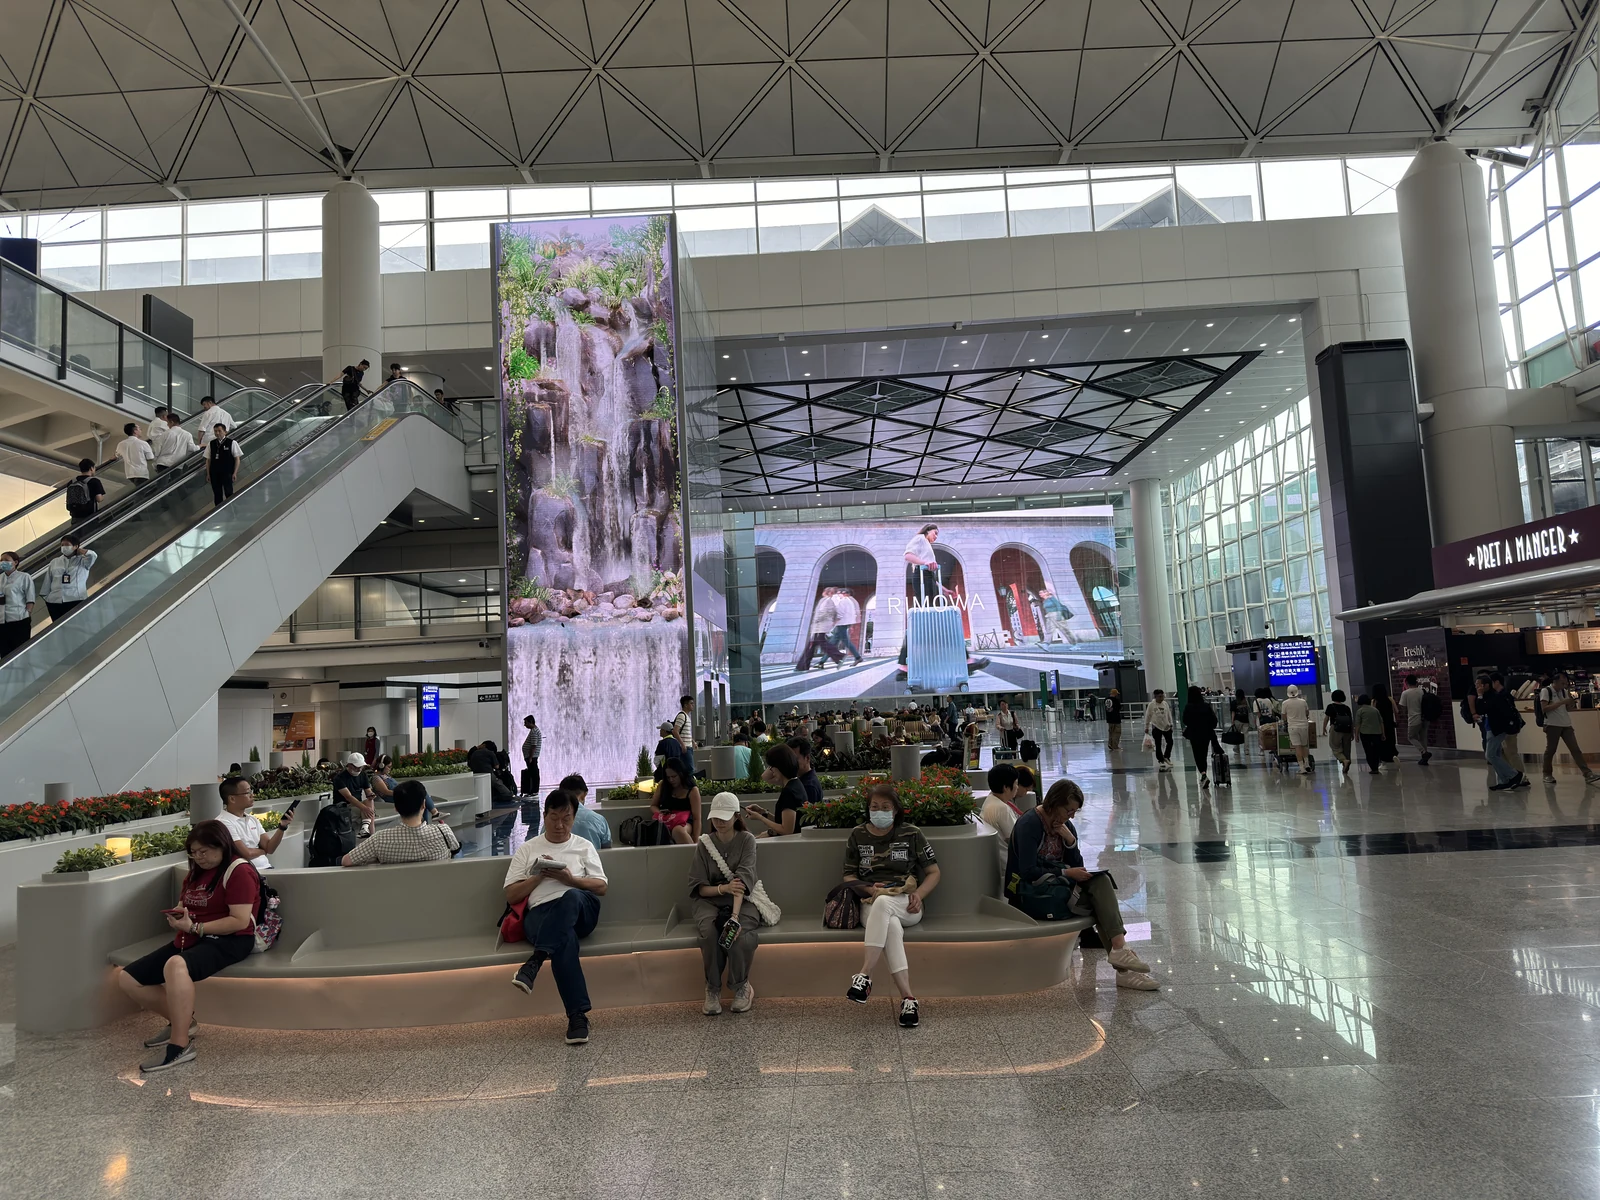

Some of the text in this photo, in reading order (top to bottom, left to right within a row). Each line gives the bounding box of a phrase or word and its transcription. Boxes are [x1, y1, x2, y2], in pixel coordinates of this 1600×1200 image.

[1477, 526, 1567, 570] PRET A MANGER
[888, 593, 985, 615] RIMOWA
[1403, 645, 1426, 658] Freshly
[1397, 657, 1436, 669] handmade food
